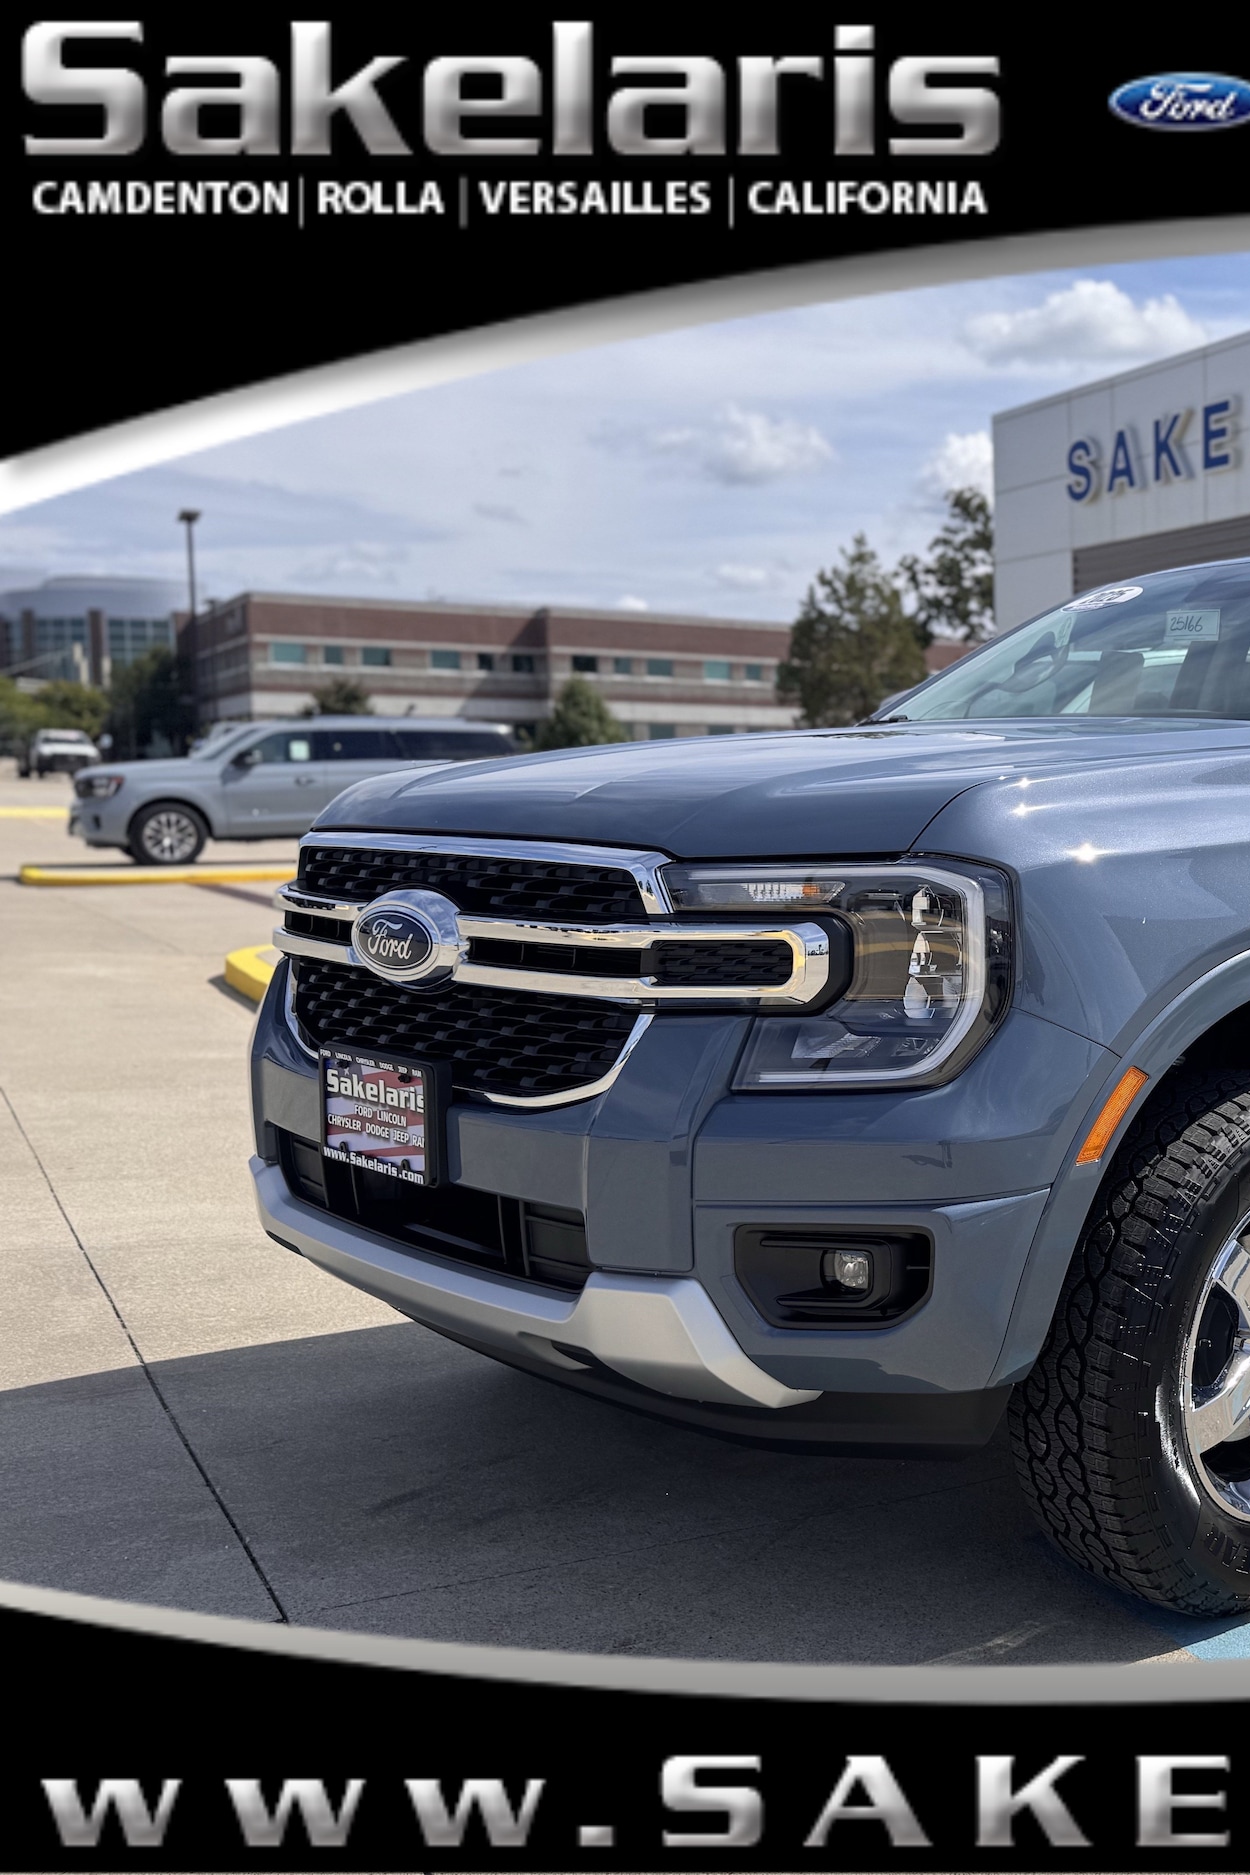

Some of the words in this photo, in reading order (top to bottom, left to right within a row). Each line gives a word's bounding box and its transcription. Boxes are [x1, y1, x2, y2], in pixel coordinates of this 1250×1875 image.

[1170, 616, 1203, 632] 25166
[367, 918, 413, 960] Ford
[327, 1069, 425, 1113] Sakelaris
[328, 1114, 361, 1131] CHRYSLER
[366, 1123, 390, 1138] DODGE
[393, 1130, 409, 1143] JEEP
[354, 1105, 373, 1118] FORD
[377, 1110, 407, 1127] LINCOLN
